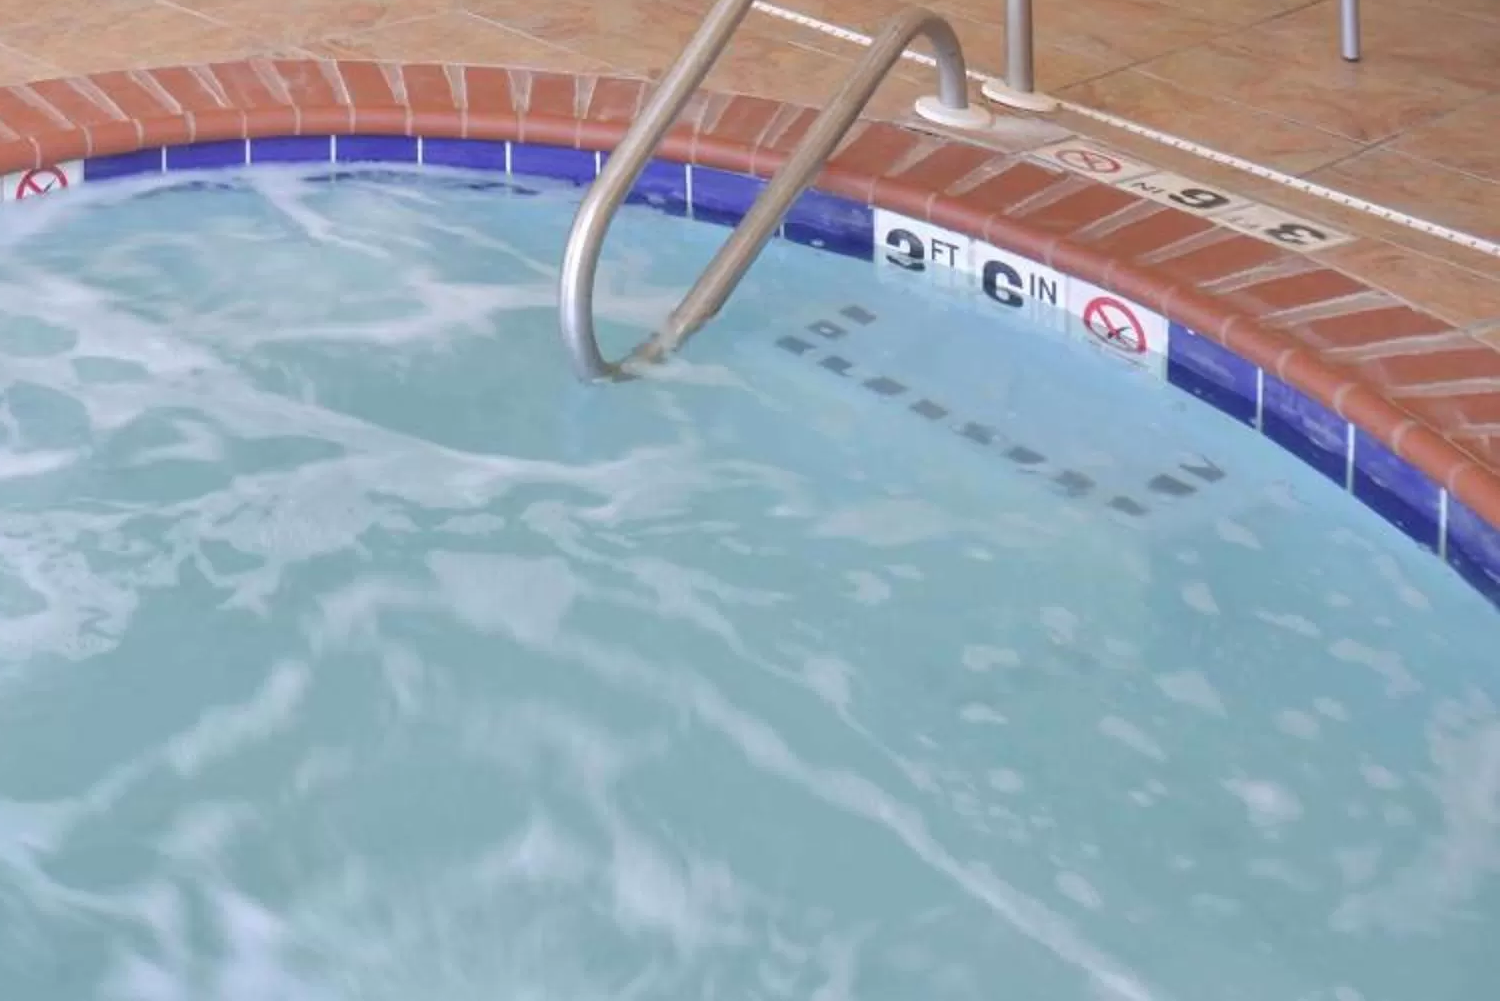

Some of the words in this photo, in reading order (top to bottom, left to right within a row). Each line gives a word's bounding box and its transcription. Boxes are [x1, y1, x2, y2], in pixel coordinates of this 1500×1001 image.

[1264, 223, 1326, 245] 3
[931, 238, 960, 268] FT
[1029, 272, 1057, 305] IN
